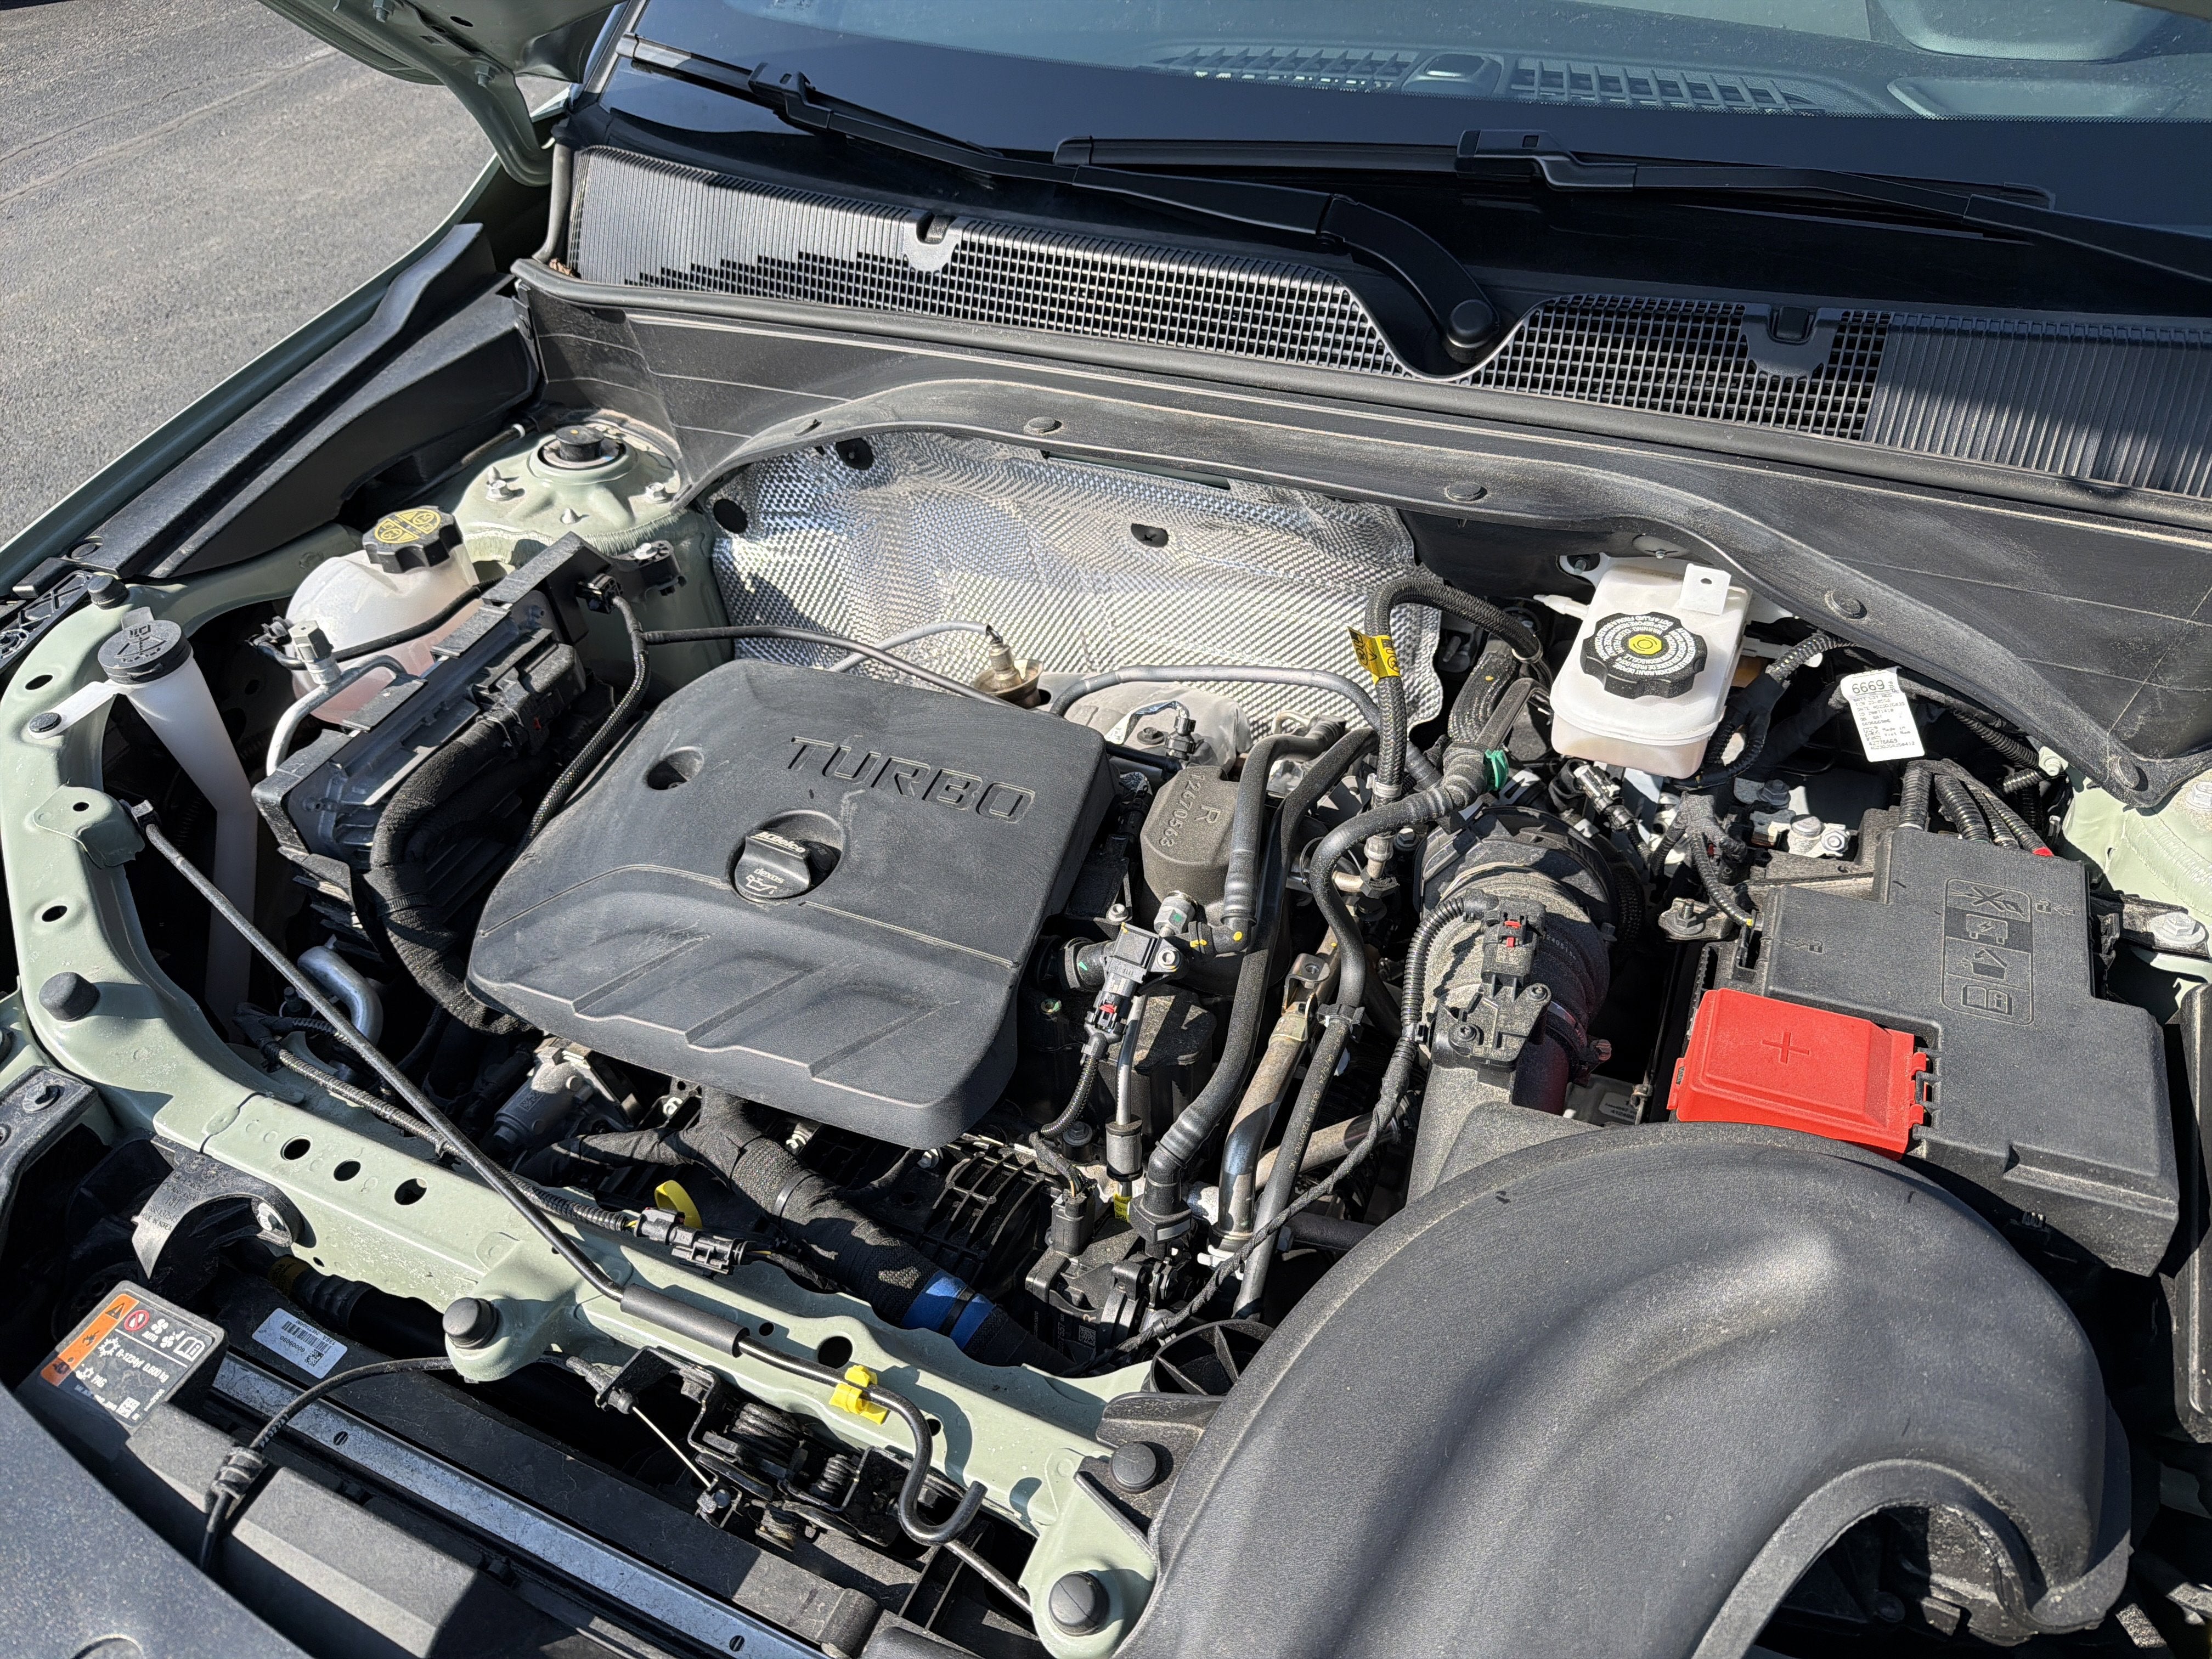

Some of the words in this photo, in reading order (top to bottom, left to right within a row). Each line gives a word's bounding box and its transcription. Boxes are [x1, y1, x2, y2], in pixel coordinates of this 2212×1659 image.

[1654, 622, 1670, 630] CAP
[1658, 618, 1674, 627] DOT
[1596, 623, 1615, 637] SEALED
[1615, 628, 1633, 640] CLEAN
[1604, 646, 1618, 657] ONLY
[1852, 680, 1884, 693] 6669
[789, 736, 1035, 822] TURBO
[1159, 774, 1205, 847] 12670563
[1194, 805, 1221, 823] R
[755, 832, 805, 853] ACDelco
[754, 868, 785, 884] dexos
[1318, 1053, 1335, 1084] 04/15/24
[165, 1196, 180, 1208] RH
[141, 1213, 152, 1222] MADE
[158, 1221, 172, 1231] KOREA
[142, 1330, 159, 1342] AUTO
[116, 1349, 144, 1368] R-1234yf
[143, 1363, 161, 1377] 0.600
[159, 1370, 170, 1383] kg
[91, 1374, 108, 1387] PAG
